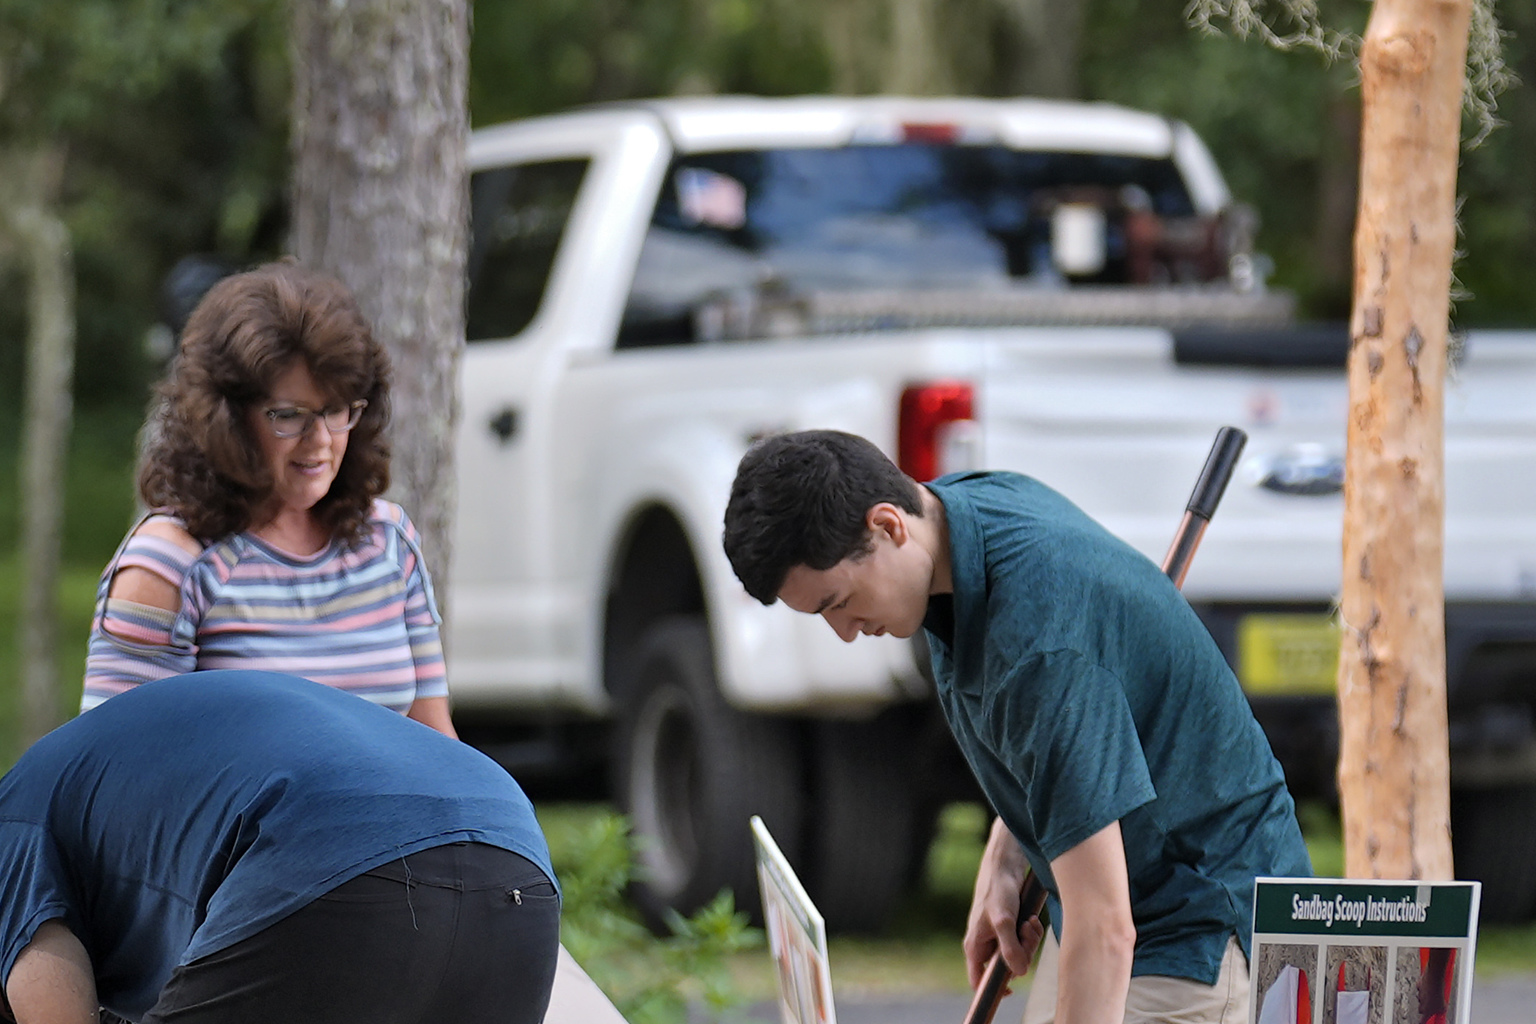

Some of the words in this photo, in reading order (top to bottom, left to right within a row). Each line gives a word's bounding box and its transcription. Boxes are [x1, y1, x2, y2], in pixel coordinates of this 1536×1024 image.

[1291, 893, 1334, 928] Sandbag
[1334, 894, 1366, 928] Scoop
[1366, 894, 1427, 923] Instructions
